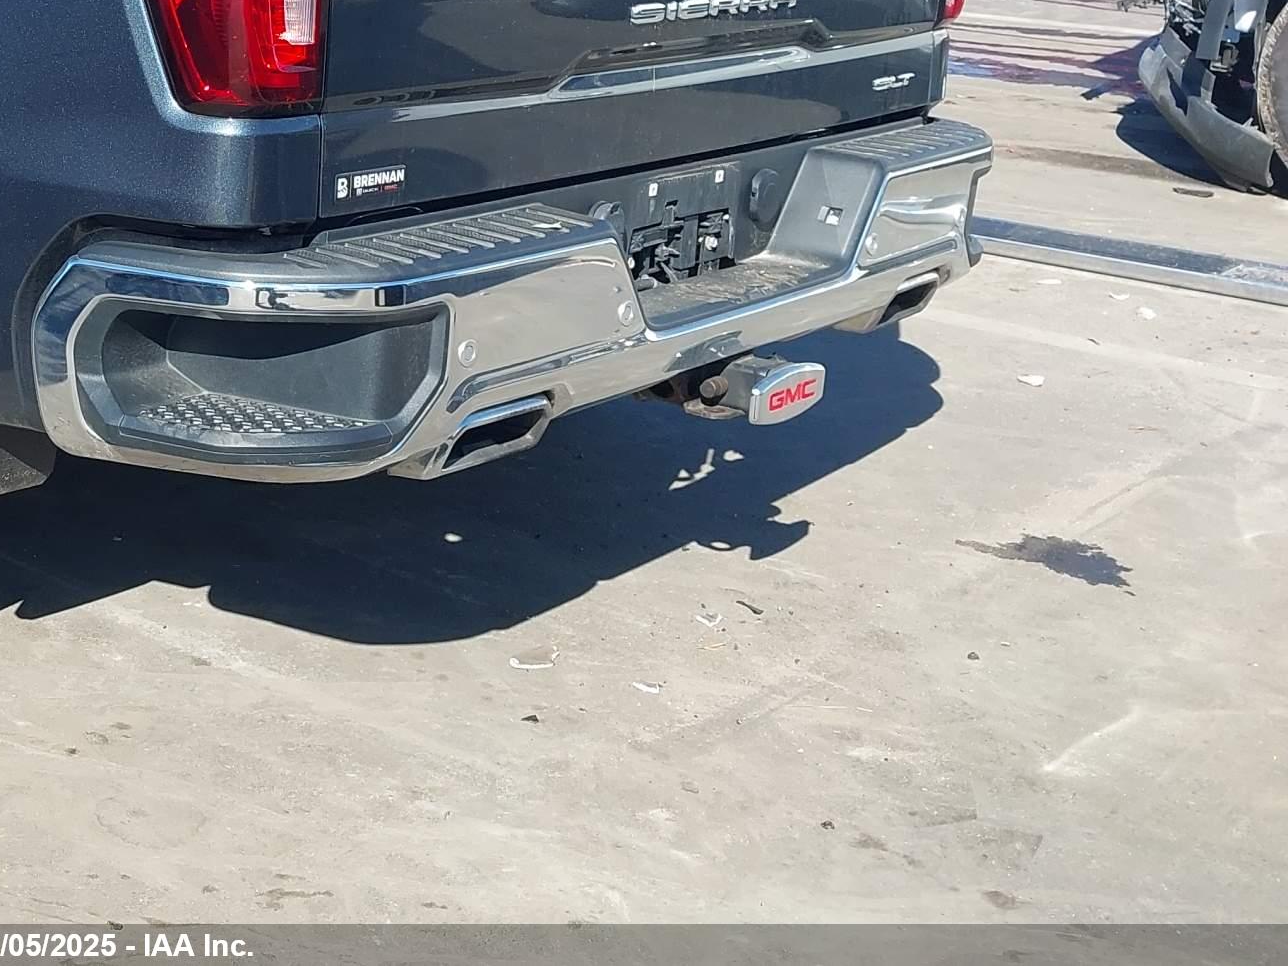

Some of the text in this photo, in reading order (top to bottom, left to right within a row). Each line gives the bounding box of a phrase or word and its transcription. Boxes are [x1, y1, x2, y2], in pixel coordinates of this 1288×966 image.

[872, 72, 915, 91] SLT
[353, 168, 405, 189] BRENNAN
[768, 378, 817, 412] GMC
